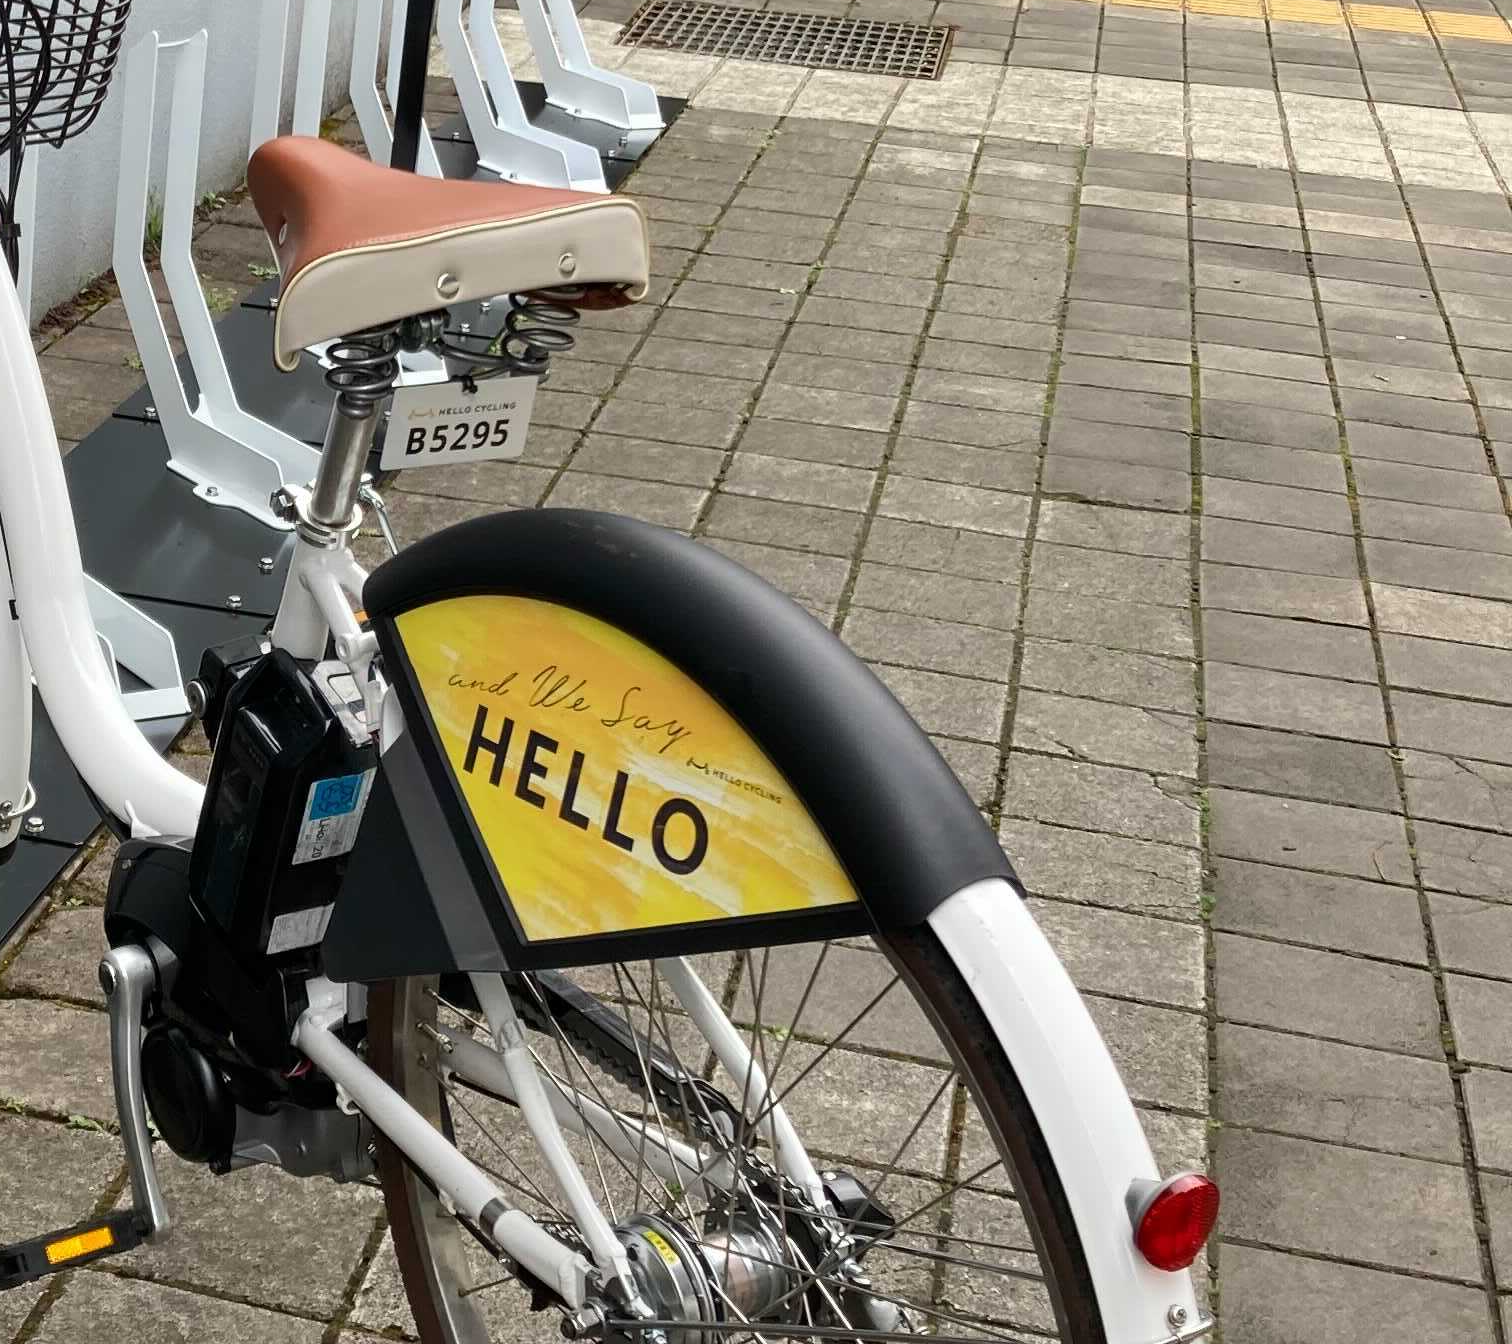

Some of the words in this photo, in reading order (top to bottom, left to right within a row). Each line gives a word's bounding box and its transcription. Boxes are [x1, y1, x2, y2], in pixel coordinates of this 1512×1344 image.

[438, 406, 471, 417] HELLO
[474, 401, 517, 413] CYCLING
[405, 419, 510, 456] B5295
[448, 671, 519, 697] and
[527, 664, 592, 712] We
[600, 687, 694, 754] Say
[462, 703, 709, 876] HELLO
[712, 769, 742, 787] HELLO
